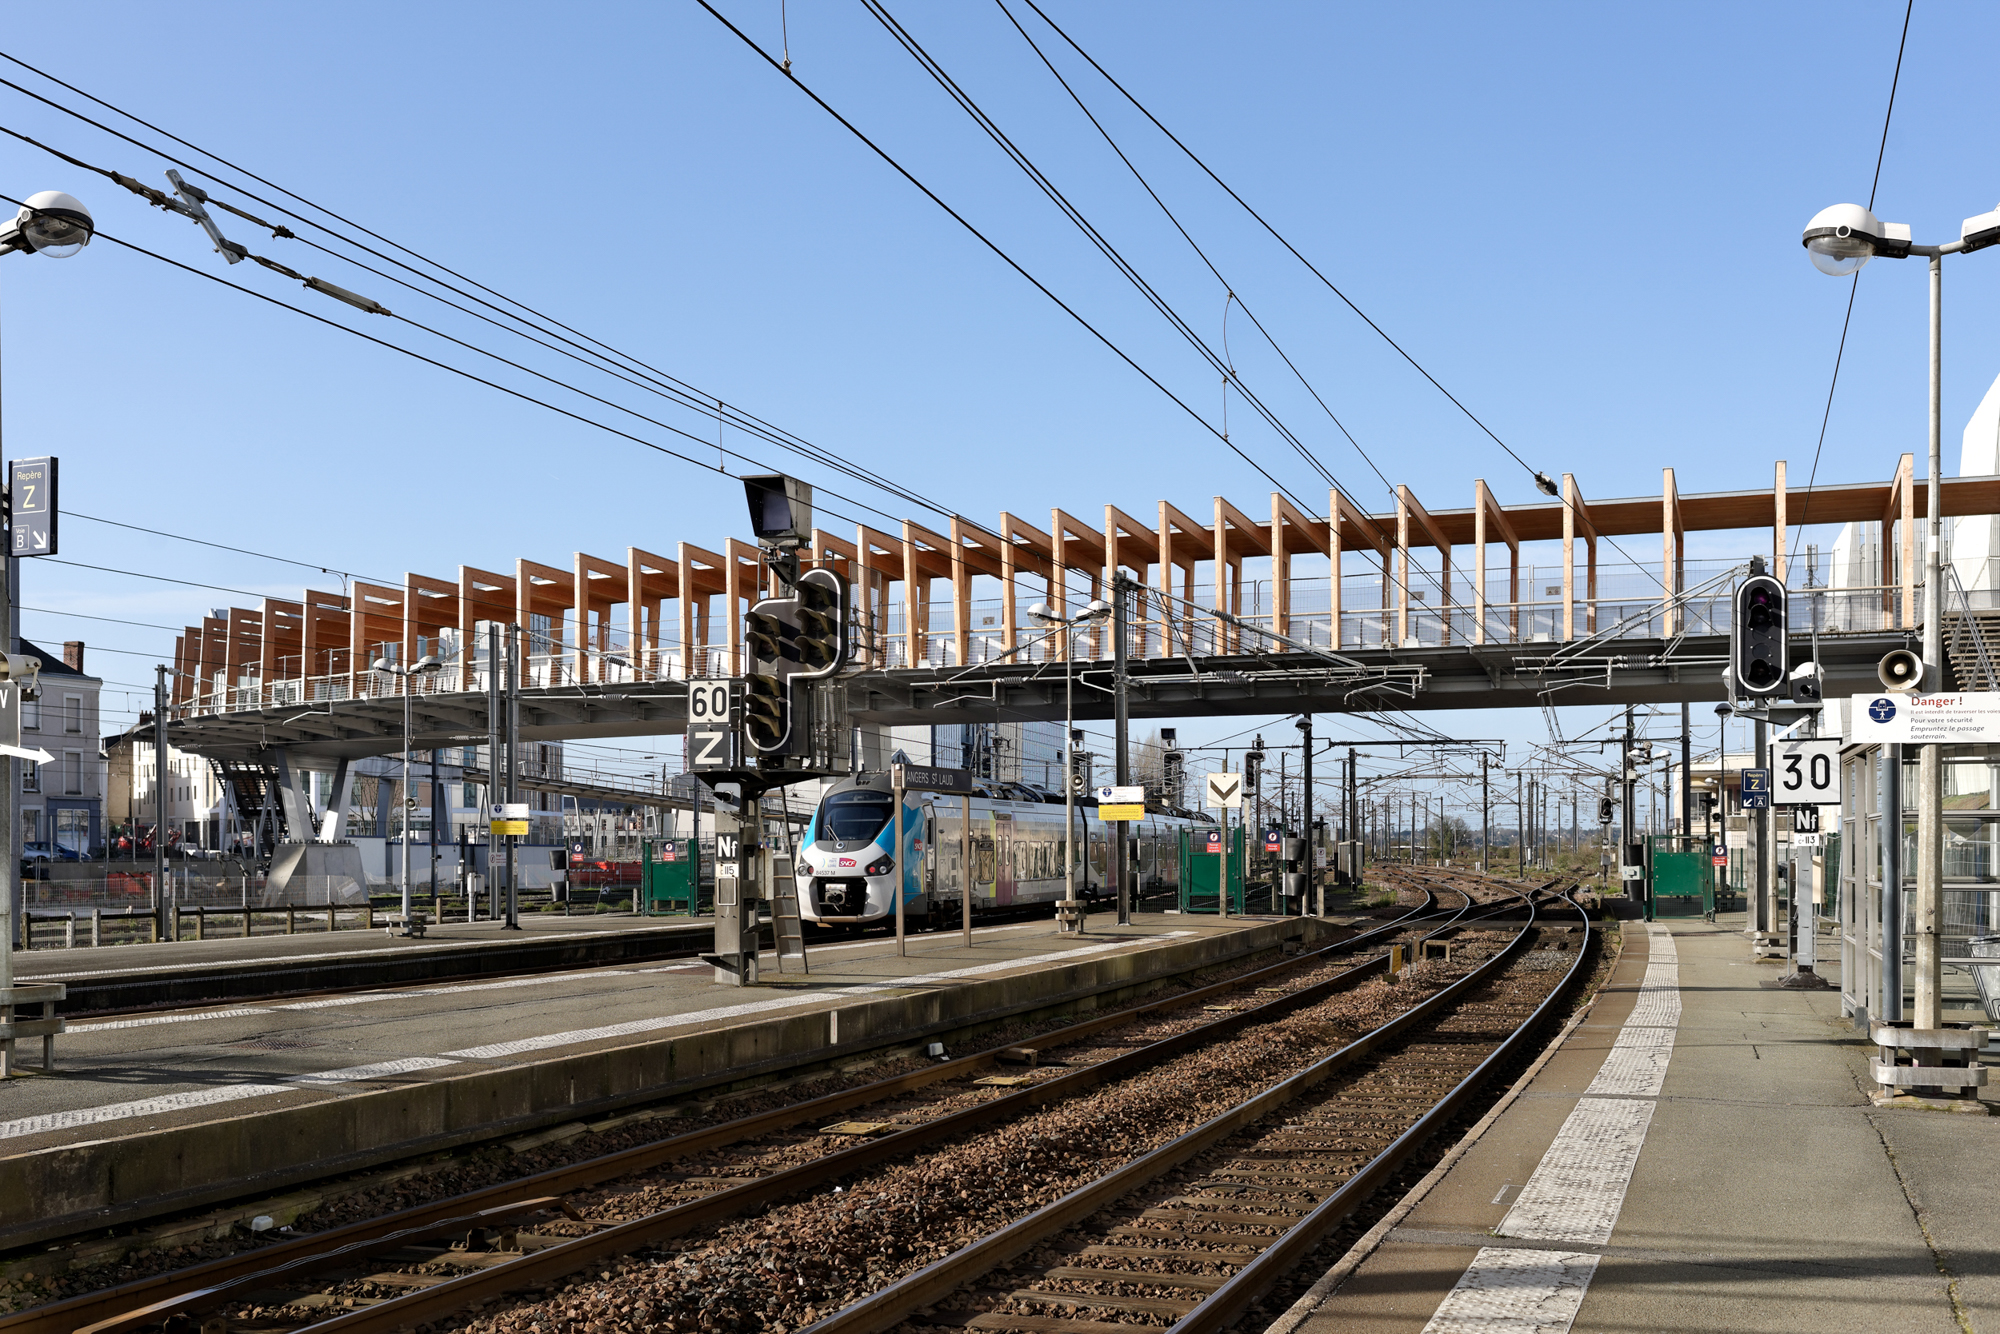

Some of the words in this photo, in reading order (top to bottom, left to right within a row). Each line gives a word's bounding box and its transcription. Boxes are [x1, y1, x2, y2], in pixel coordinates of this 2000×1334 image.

[17, 471, 42, 481] Repère
[23, 485, 36, 508] Z
[16, 535, 24, 548] B
[692, 686, 727, 717] 60
[1911, 697, 1955, 708] Danger
[695, 731, 723, 764] Z
[906, 771, 929, 784] ANGERS
[939, 774, 954, 786] LAUD
[1783, 753, 1830, 790] 30
[1751, 779, 1759, 789] Z
[1796, 810, 1817, 829] Nf
[717, 835, 738, 857] Nf
